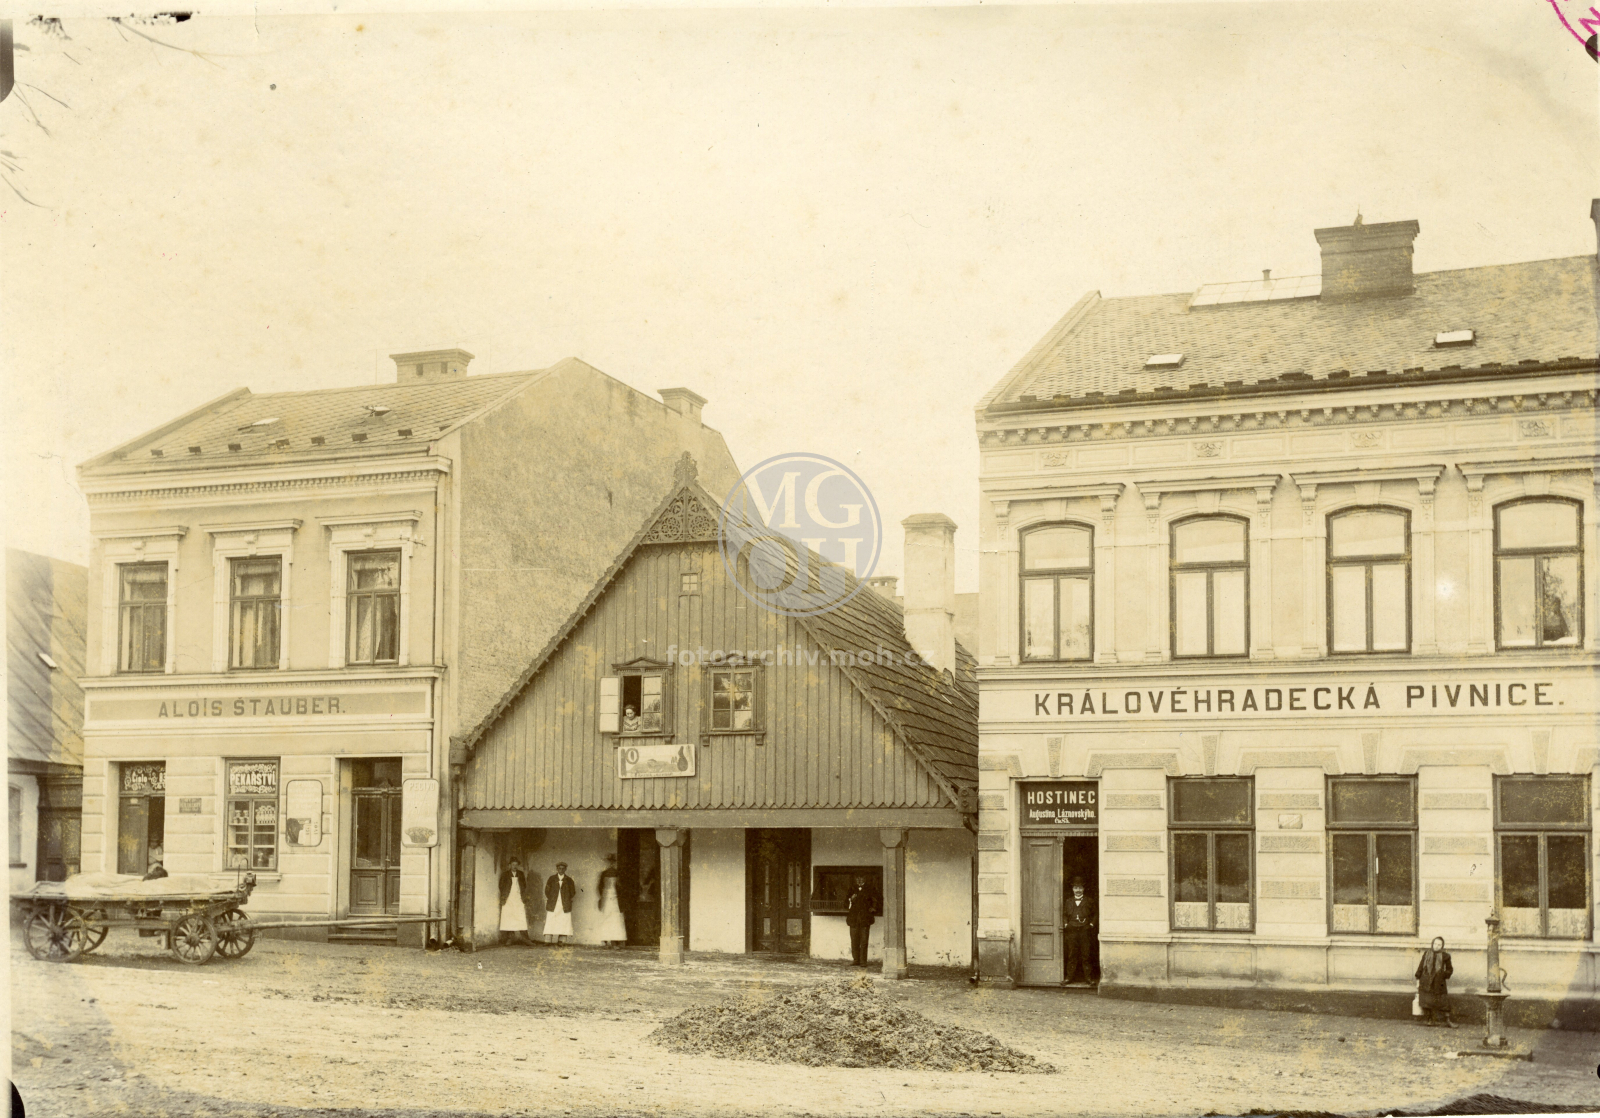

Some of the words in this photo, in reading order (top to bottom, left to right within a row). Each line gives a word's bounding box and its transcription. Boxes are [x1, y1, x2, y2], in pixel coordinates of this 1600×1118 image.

[1034, 682, 1381, 716] KRÁLOVÉHRADECKÁ
[1406, 682, 1565, 709] PIVNICE.
[1027, 790, 1096, 805] HOSTINEC
